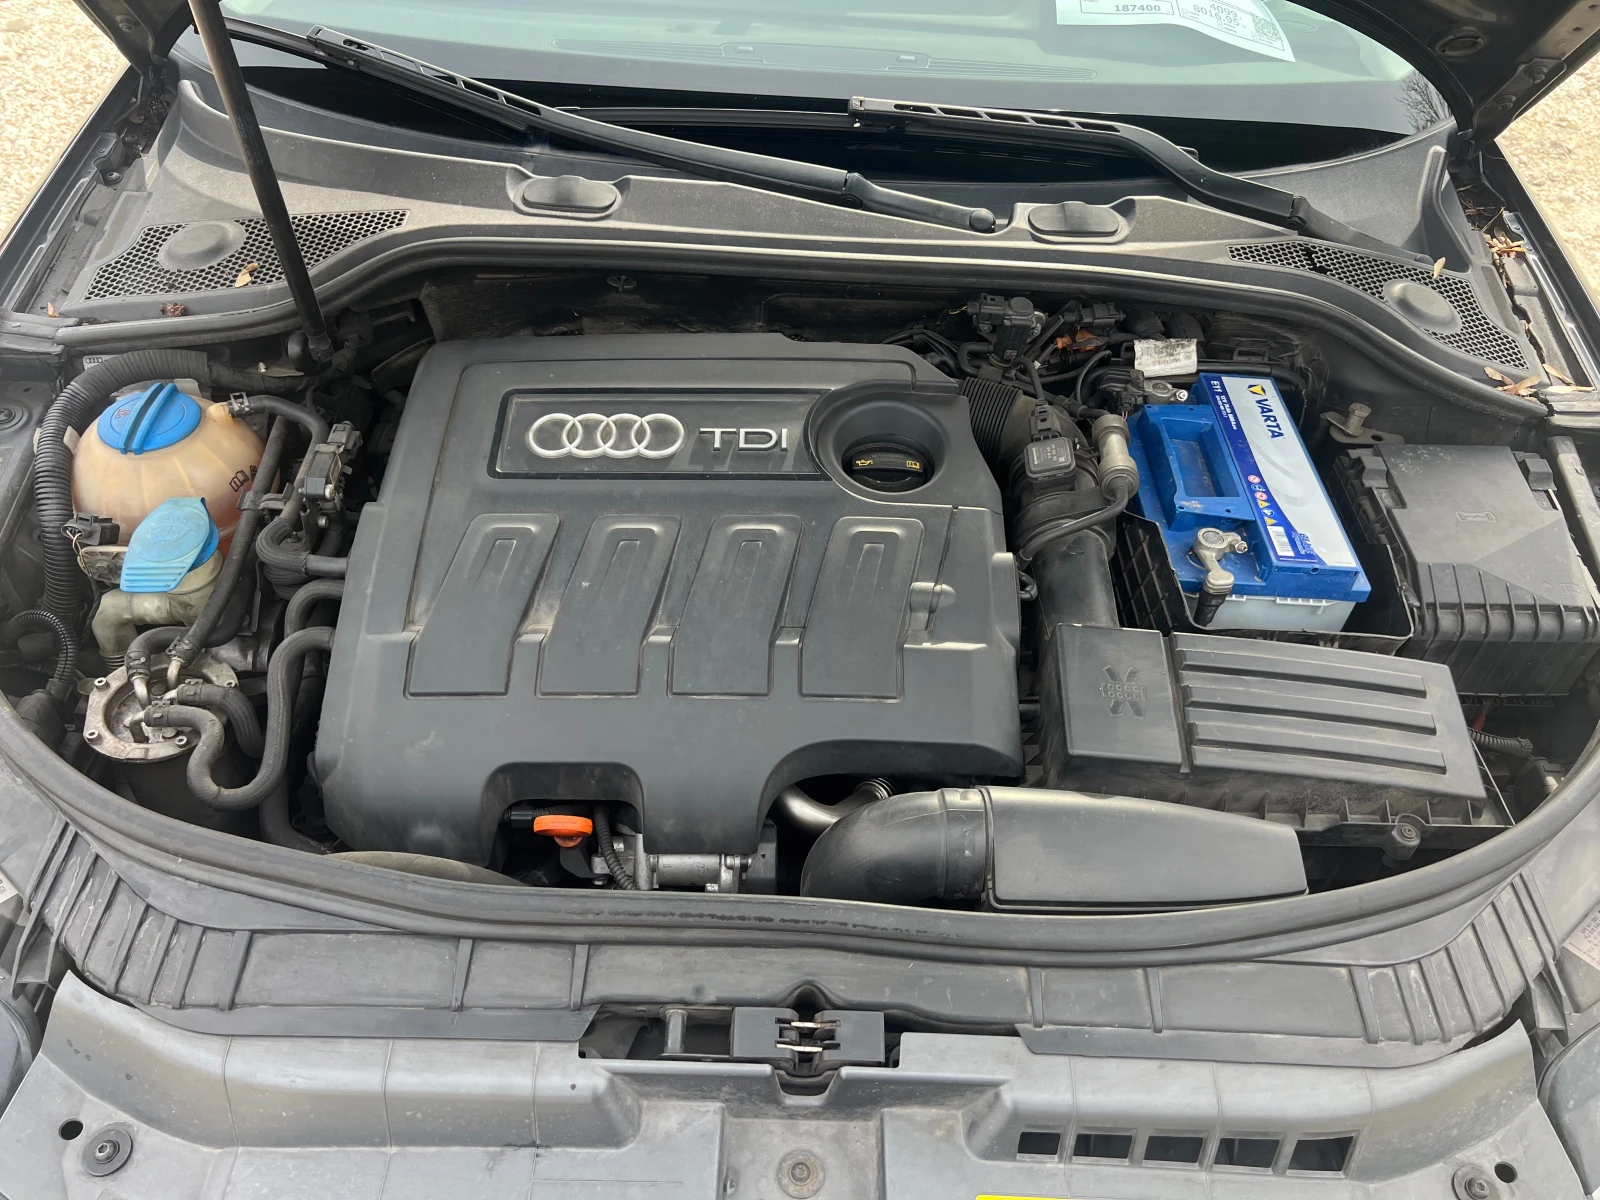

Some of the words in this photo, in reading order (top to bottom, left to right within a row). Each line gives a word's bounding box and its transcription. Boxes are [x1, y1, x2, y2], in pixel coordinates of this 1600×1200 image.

[1114, 4, 1161, 12] 187400
[1193, 4, 1240, 27] 8016.95
[1211, 380, 1222, 393] E11
[1255, 398, 1284, 439] VARTA
[699, 428, 788, 450] TDI
